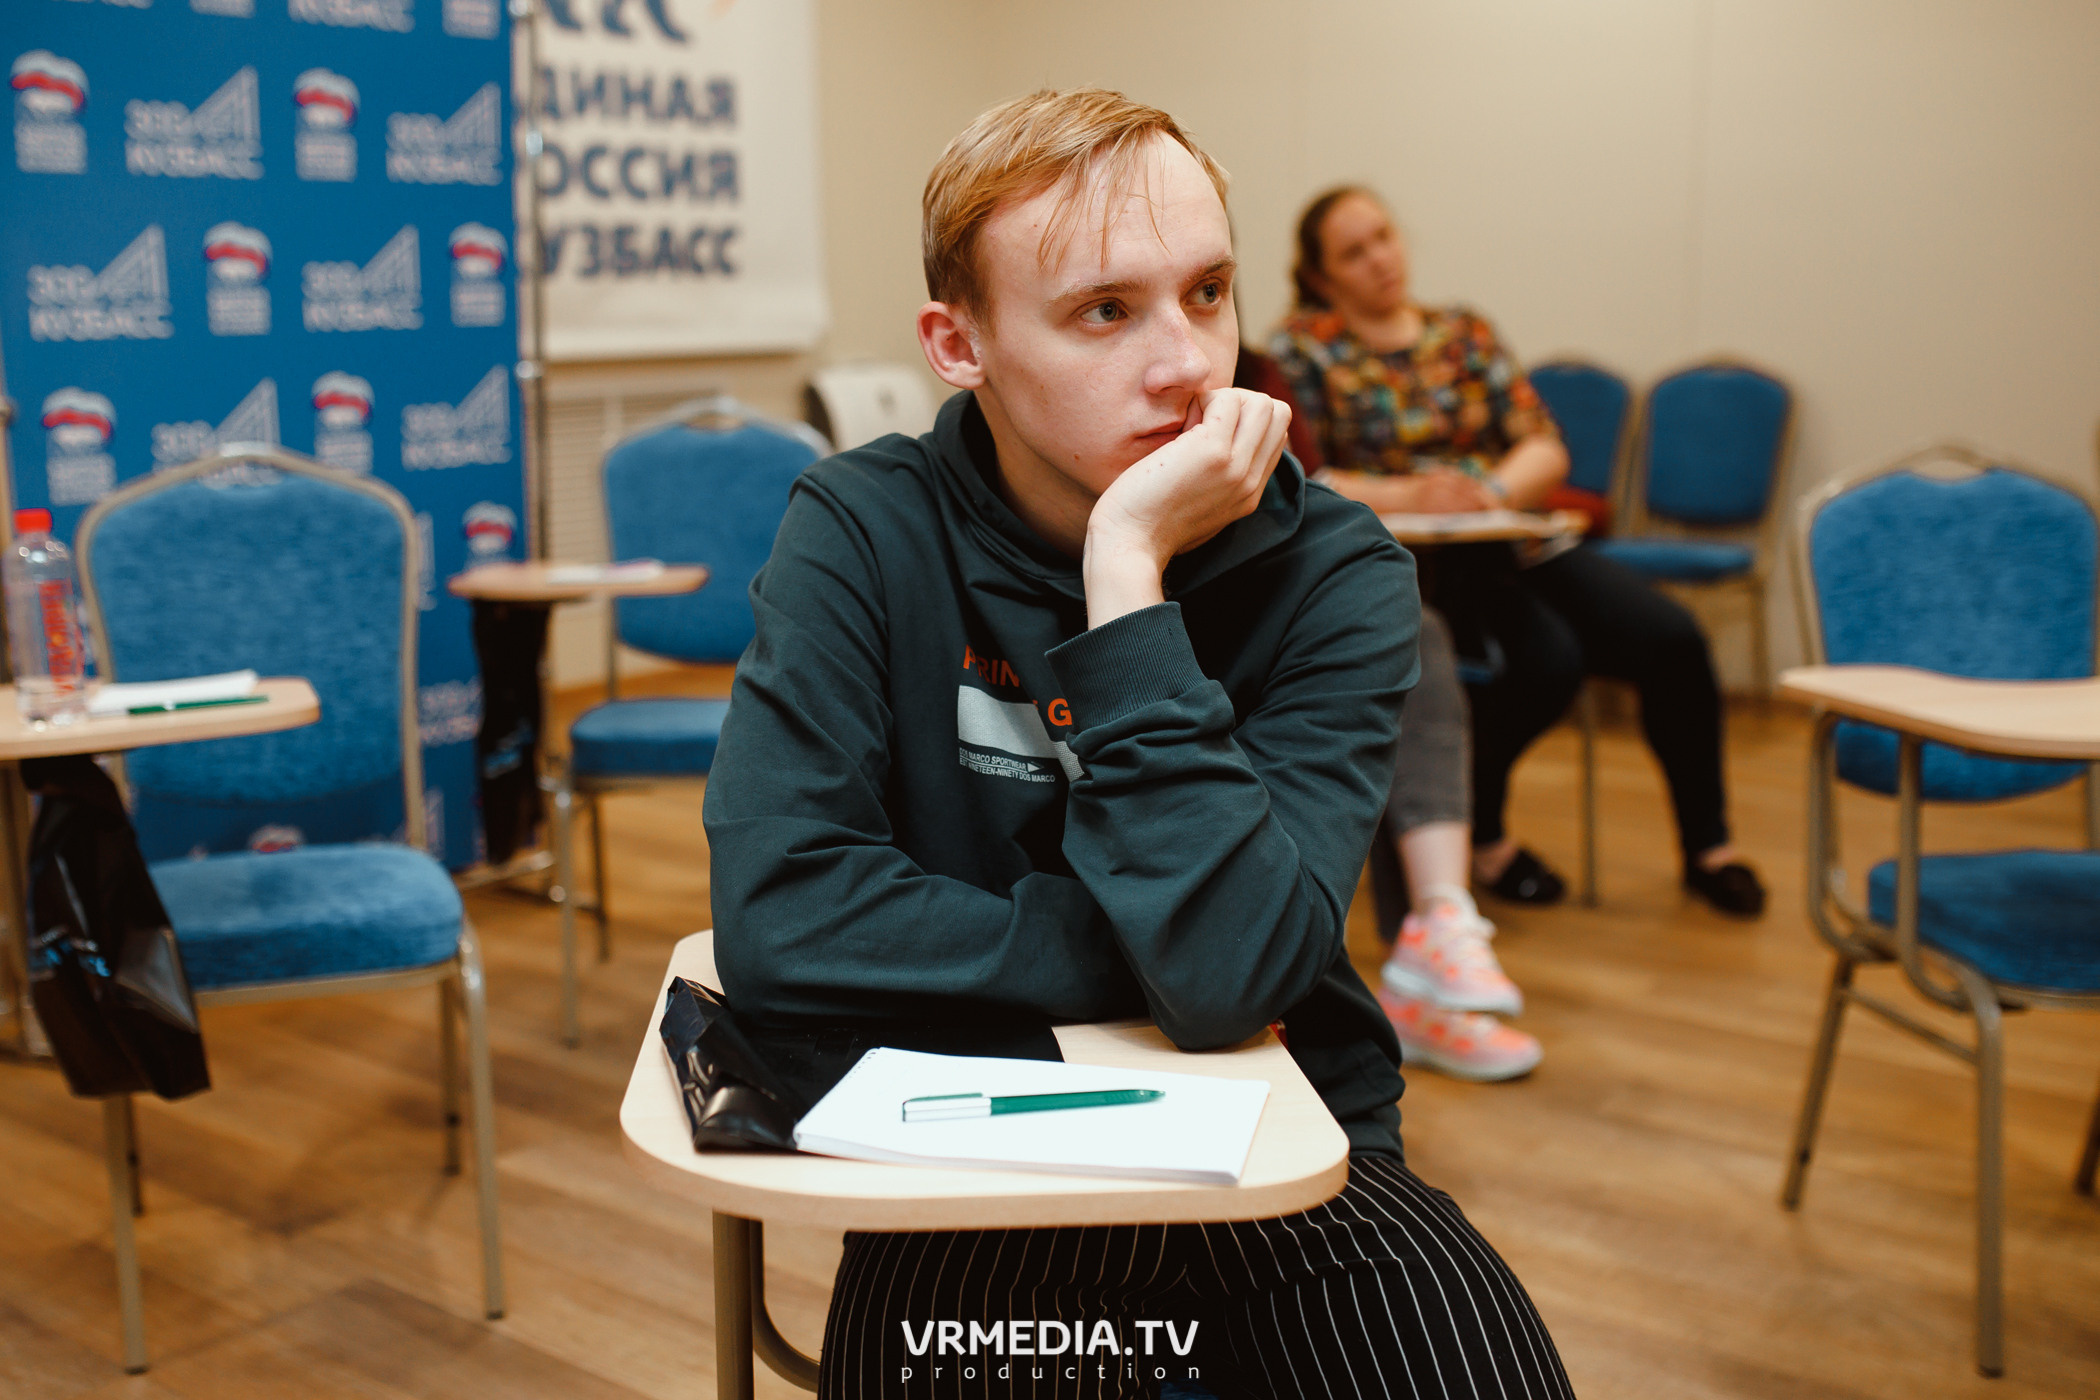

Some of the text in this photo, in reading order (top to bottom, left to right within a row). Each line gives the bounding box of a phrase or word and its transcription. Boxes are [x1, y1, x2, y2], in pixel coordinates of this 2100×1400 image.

[537, 63, 738, 125] ДИНАЯ
[536, 142, 740, 202] ОССИЯ
[538, 222, 738, 281] УЗБАСС
[963, 644, 1021, 688] PRIN
[969, 751, 990, 764] MARCO
[991, 755, 1027, 770] SPORTWEAR
[1019, 771, 1031, 782] DOS
[1031, 774, 1056, 783] MARCO
